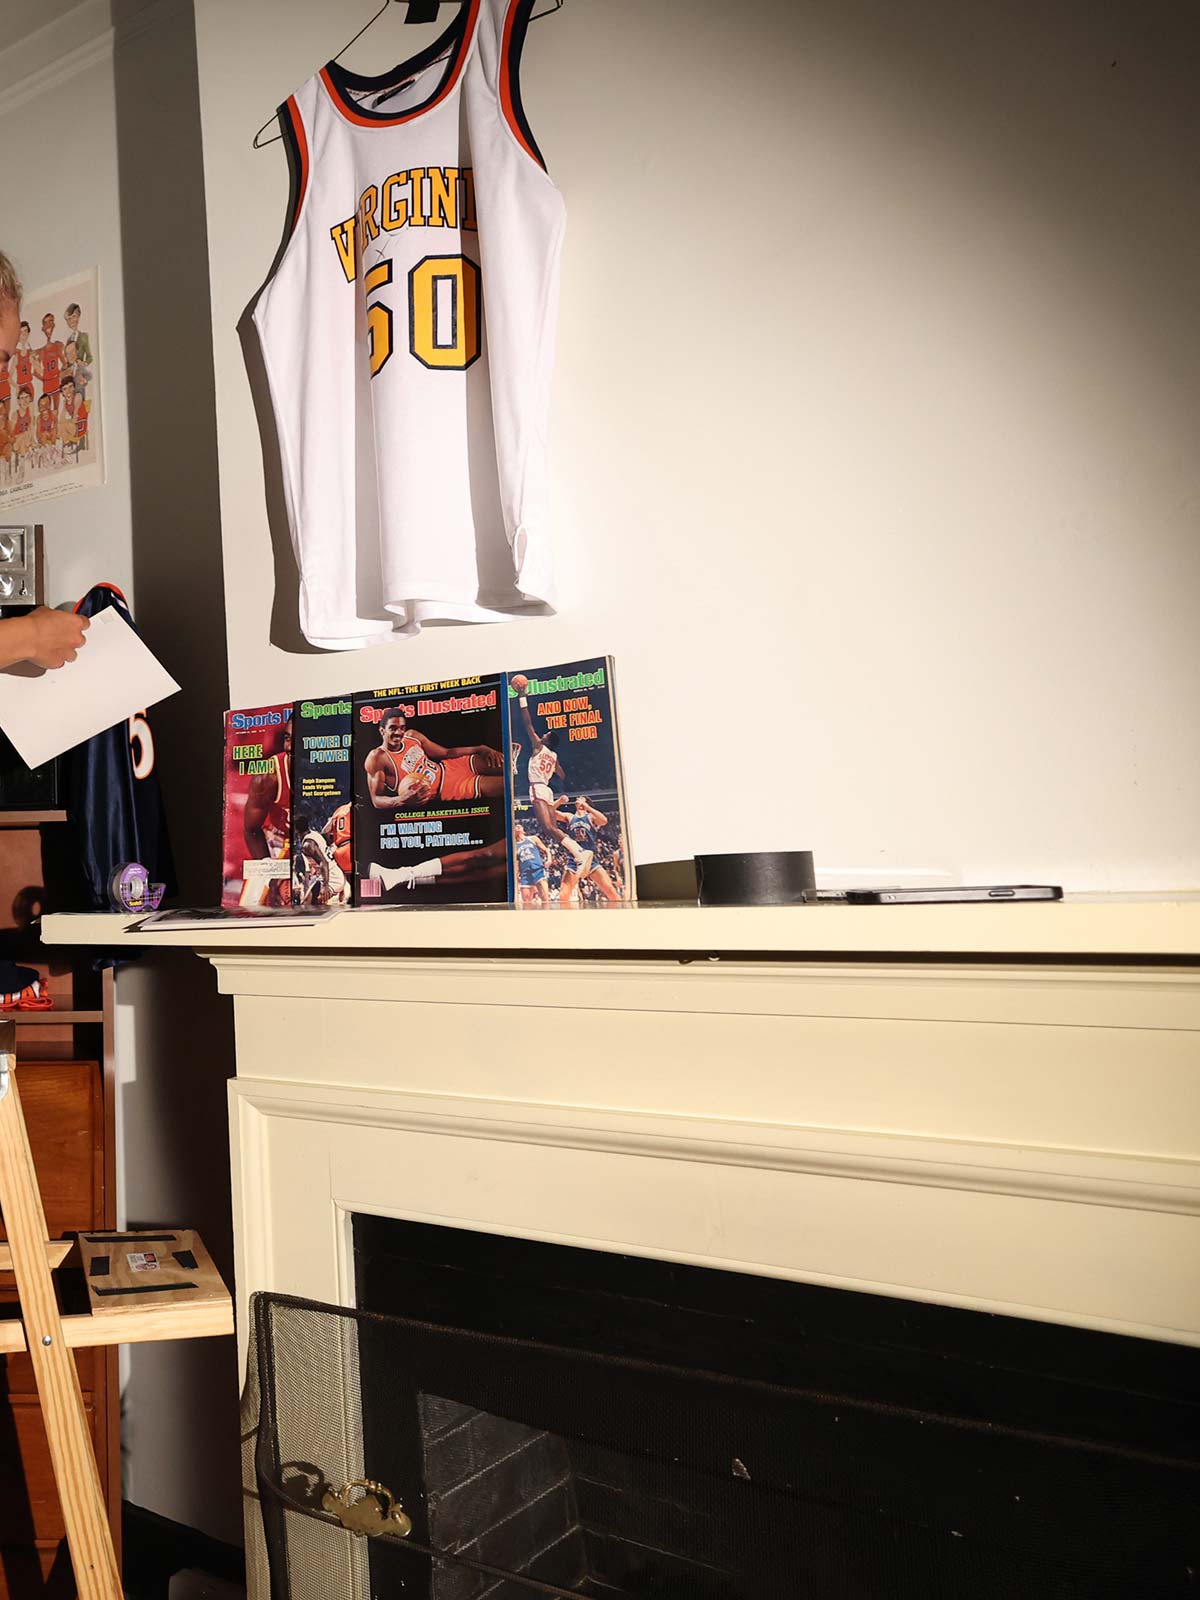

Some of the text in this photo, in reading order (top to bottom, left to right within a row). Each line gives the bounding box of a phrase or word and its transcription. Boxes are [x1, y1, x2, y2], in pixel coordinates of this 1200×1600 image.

[330, 167, 478, 284] VRGINI
[373, 675, 481, 698] THE NFL: THE FIRST WEEK BACK
[525, 668, 605, 696] llustrated
[301, 700, 352, 720] Sports
[360, 690, 497, 724] Sps Illustrated
[537, 696, 592, 716] AND NOW,
[232, 711, 281, 730] Sports
[546, 710, 602, 729] THE FINAL
[302, 735, 340, 749] TOWER
[569, 726, 598, 741] FOUR
[233, 744, 263, 760] HERE
[310, 749, 349, 763] POWER
[239, 758, 274, 775] I AM!
[427, 808, 470, 817] BASKETBALL
[471, 806, 490, 814] ISSUE
[380, 821, 443, 836] I'M WAITING
[380, 837, 400, 849] FOR
[400, 836, 424, 849] YOU,
